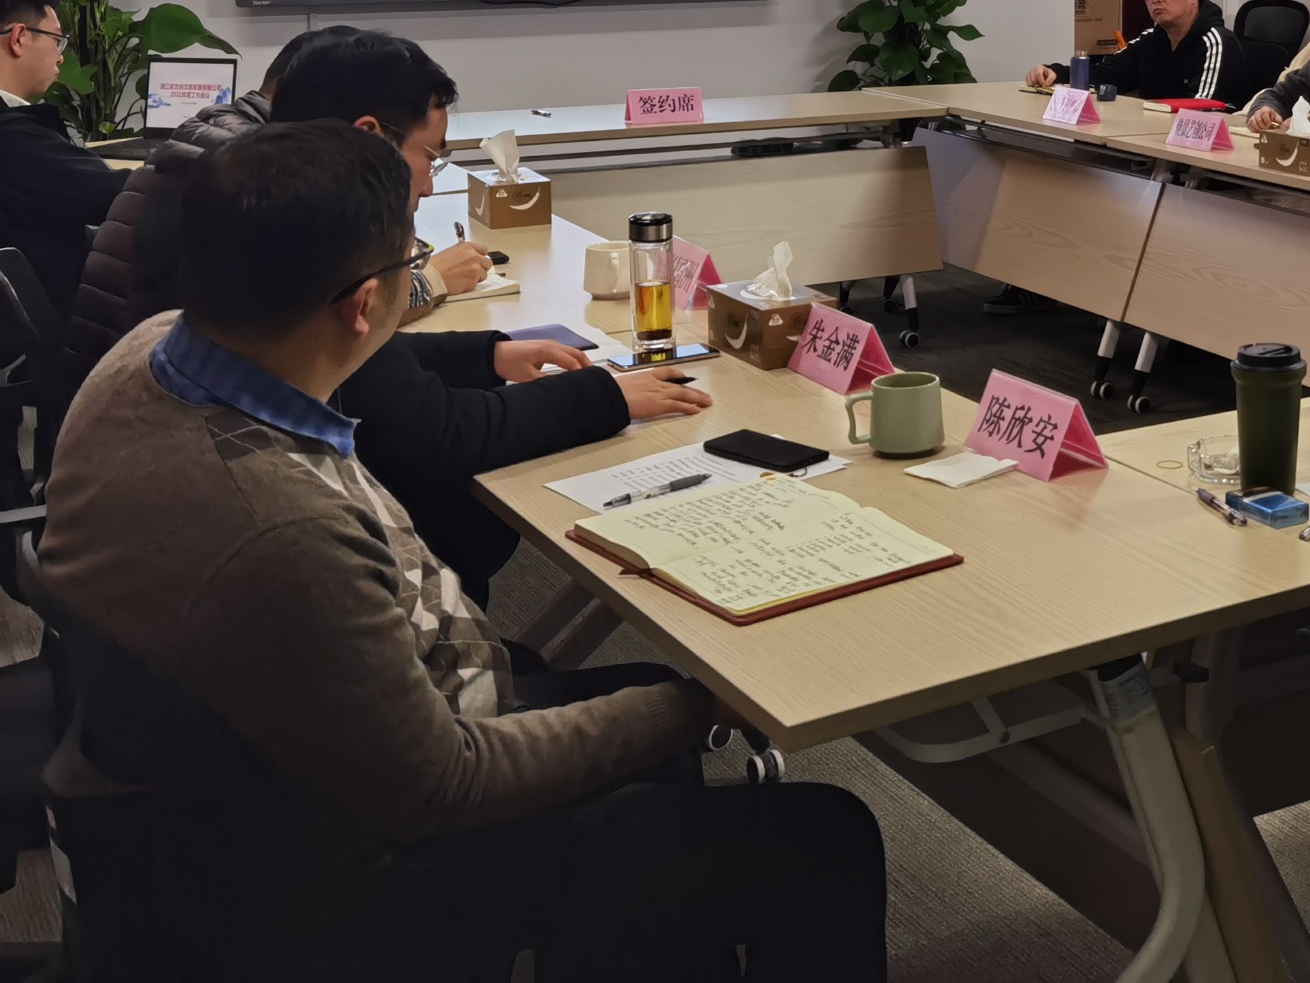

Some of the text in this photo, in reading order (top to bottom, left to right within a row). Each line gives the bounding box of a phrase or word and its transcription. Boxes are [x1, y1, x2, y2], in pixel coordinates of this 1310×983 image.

[638, 93, 695, 115] 签约席
[801, 318, 860, 372] 朱金满
[976, 394, 1059, 459] 陈欣安
